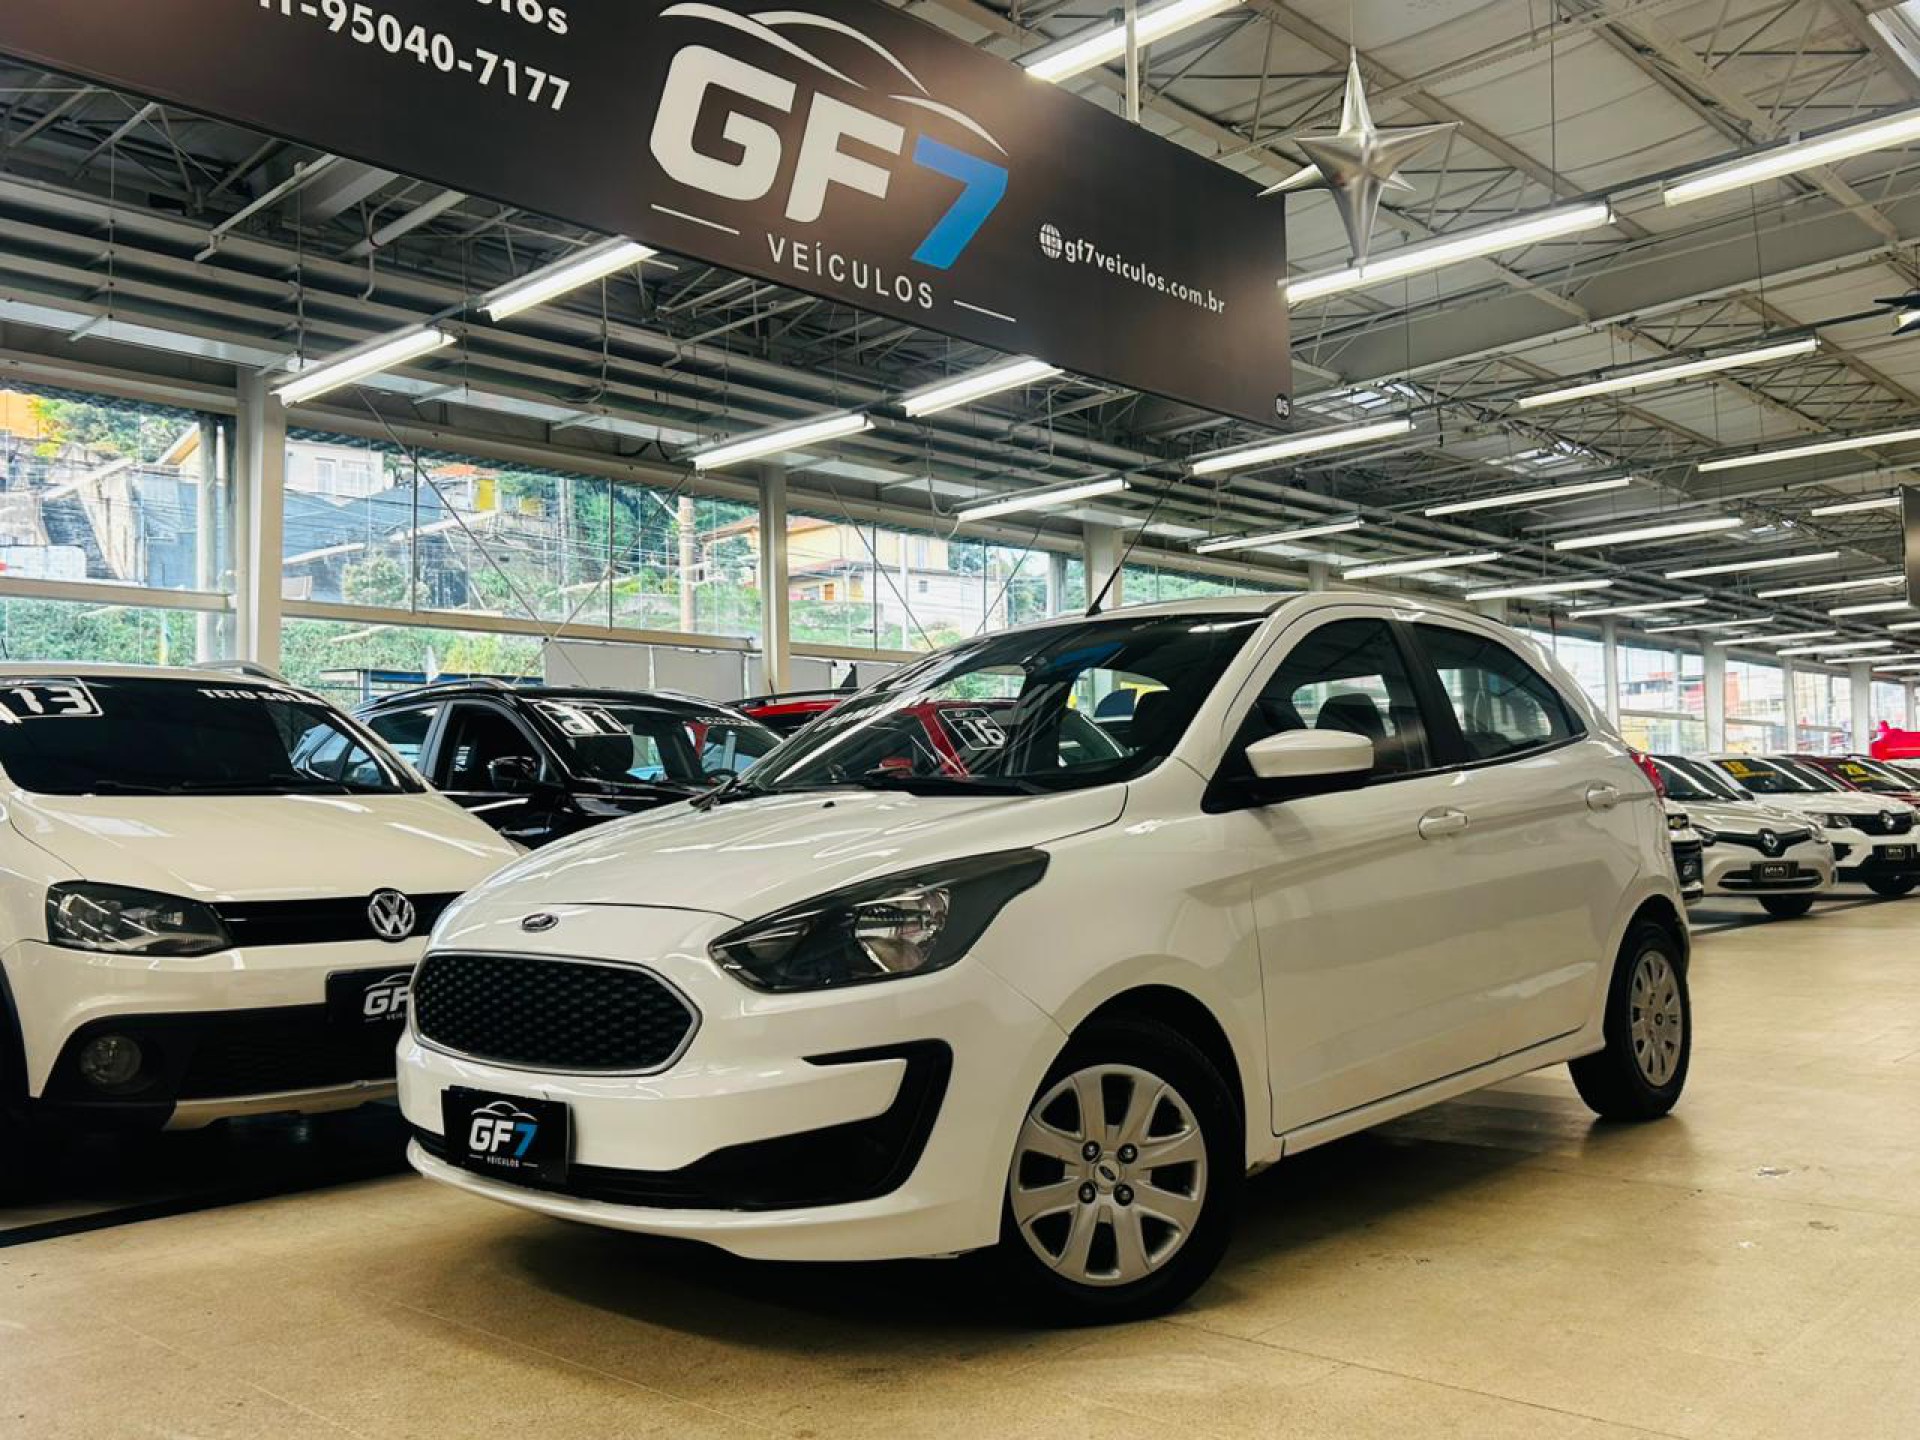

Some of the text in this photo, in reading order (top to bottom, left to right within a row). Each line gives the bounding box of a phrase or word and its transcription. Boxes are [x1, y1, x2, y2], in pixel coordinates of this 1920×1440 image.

[258, 0, 571, 111] -95040-7177
[650, 44, 1009, 270] GF7
[767, 233, 933, 309] VEÍCULOS
[1064, 238, 1225, 314] gf7veiculos.com.br
[963, 719, 1006, 745] 16
[363, 986, 409, 1015] GF
[469, 1118, 537, 1158] GF7
